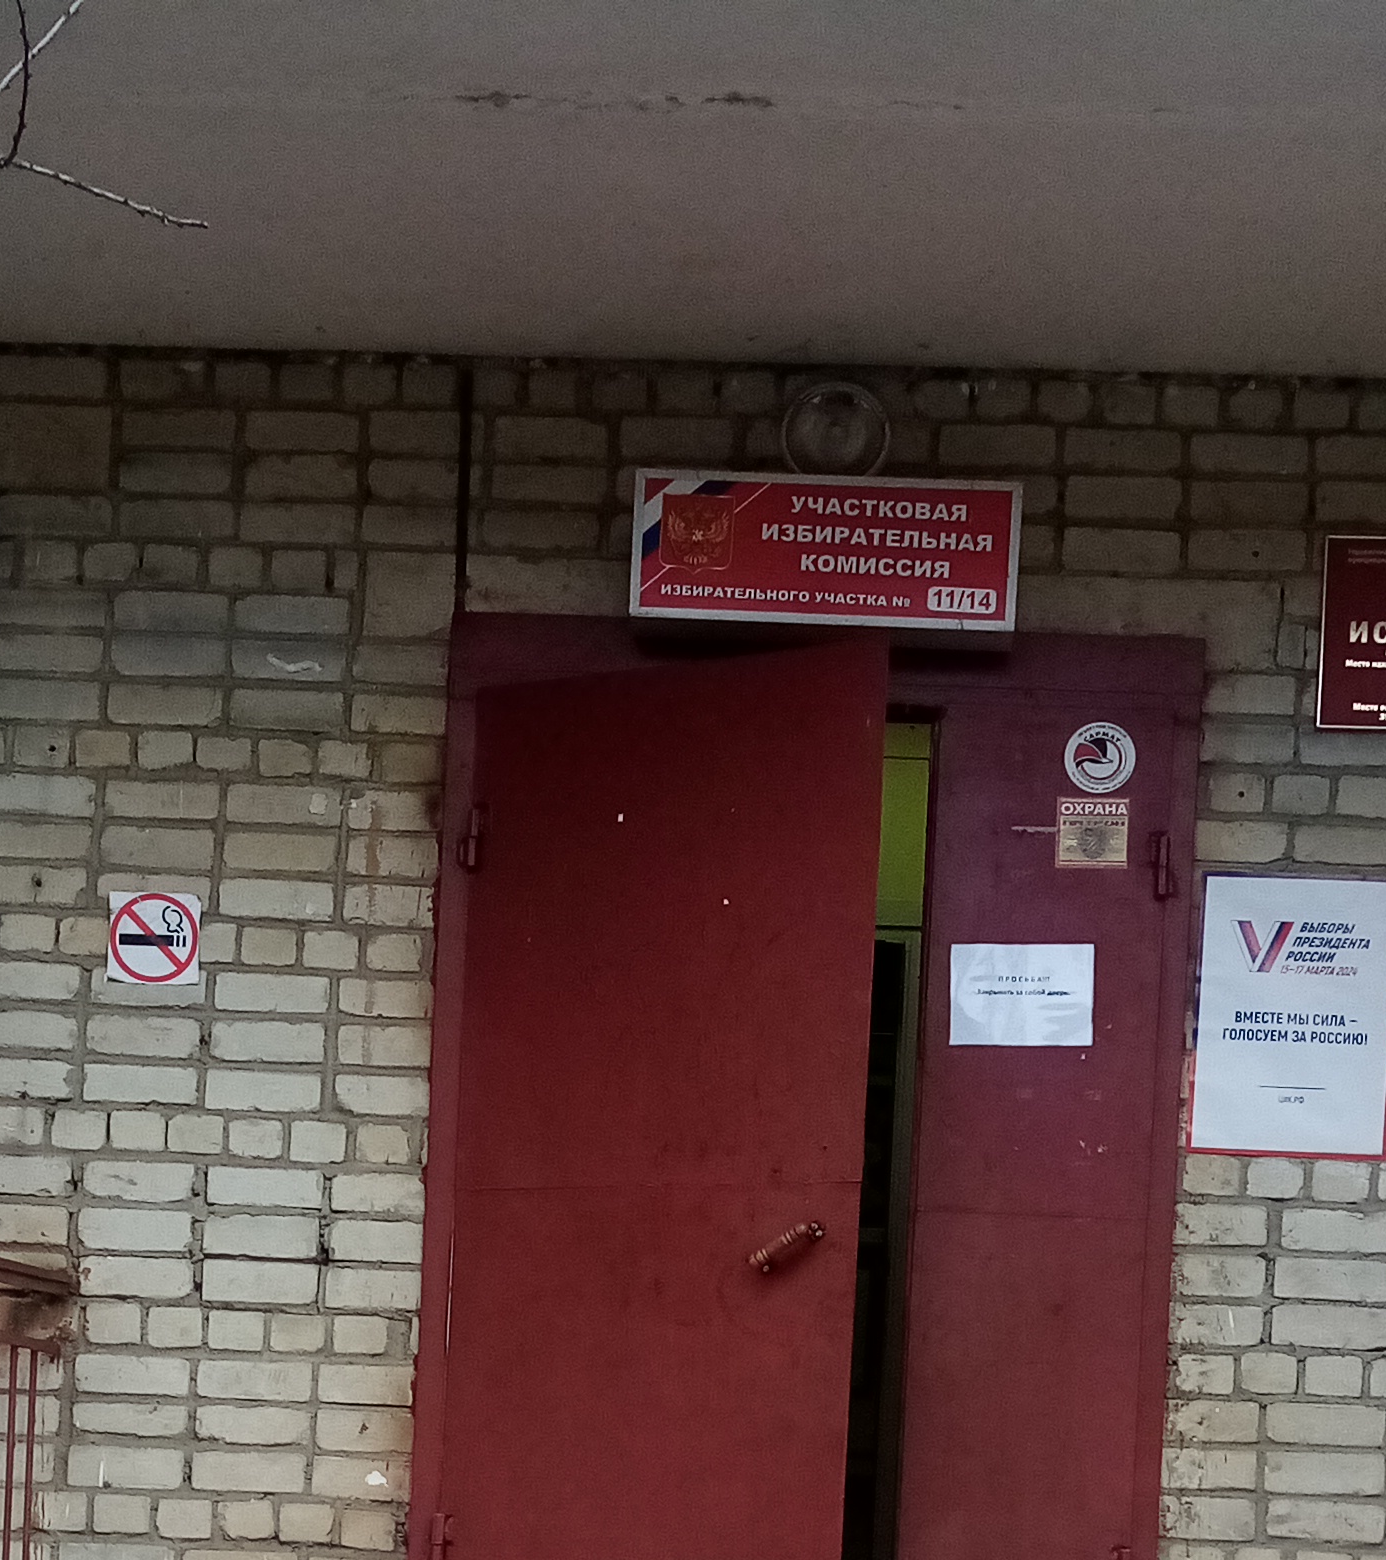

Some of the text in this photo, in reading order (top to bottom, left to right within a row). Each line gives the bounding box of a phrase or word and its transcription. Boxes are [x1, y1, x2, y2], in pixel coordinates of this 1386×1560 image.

[791, 495, 968, 523] УЧАСТКОВАЯ
[761, 523, 993, 552] ИЗБИРАТЕЛЬНАЯ
[800, 554, 951, 579] КОМИССИЯ
[660, 584, 992, 612] ИЗБИРАТЕЛЬНОГО УЧАСТКА № 11/14
[1061, 803, 1127, 815] ОХРАНА
[1300, 921, 1356, 934] ВЫБОРЫ
[1292, 936, 1371, 949] ПРЕЗИДЕНТА
[1285, 951, 1337, 963] РОССИИ
[1305, 965, 1335, 975] МАРТА
[1336, 966, 1359, 976] 2024
[1235, 1011, 1283, 1024] ВМЕСТЕ
[1287, 1013, 1309, 1025] МЫ
[1313, 1014, 1346, 1027] СИЛА
[1222, 1028, 1368, 1045] ГОЛОСУЕМ ЗА РОССИЮ!
